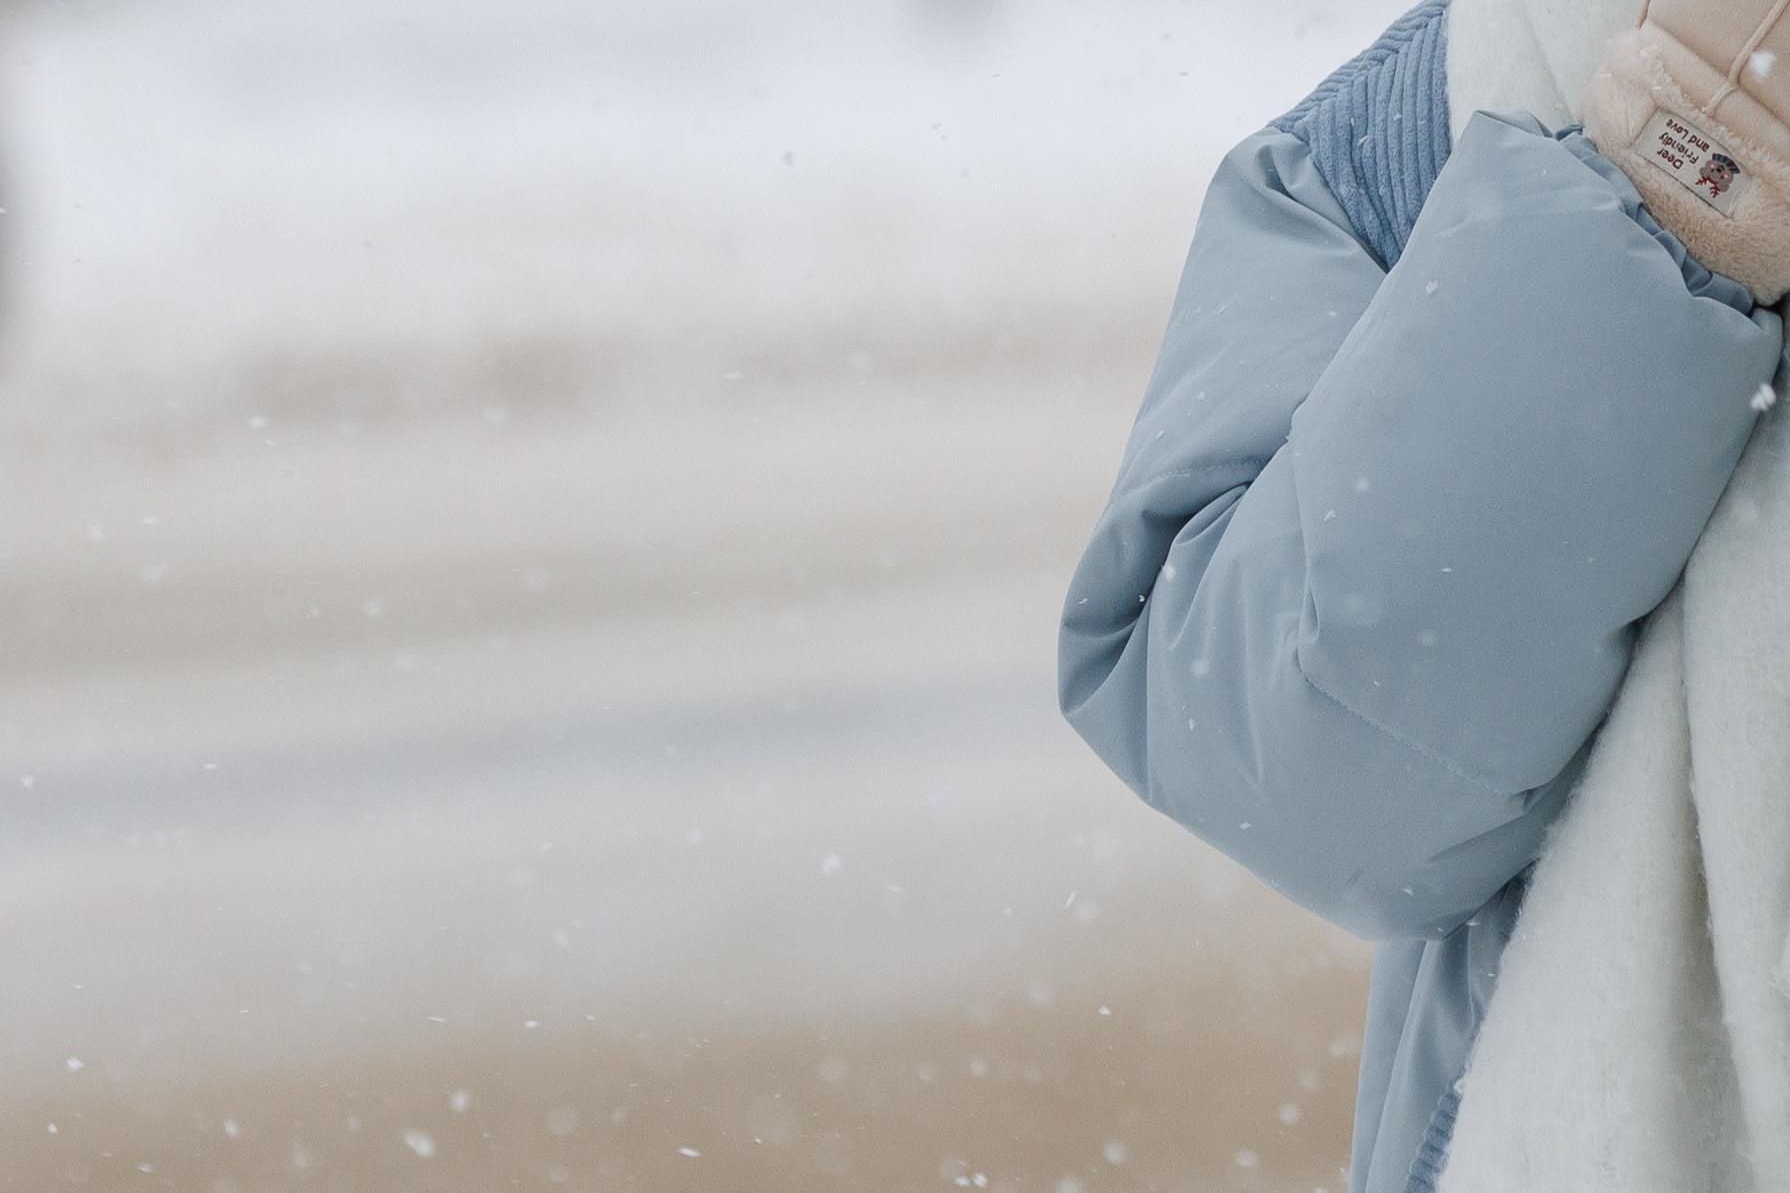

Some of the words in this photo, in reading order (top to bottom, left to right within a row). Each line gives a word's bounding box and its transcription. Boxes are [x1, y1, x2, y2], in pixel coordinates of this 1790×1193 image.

[1666, 118, 1689, 140] Love
[1658, 133, 1699, 165] Friendly
[1687, 134, 1710, 152] and
[1657, 148, 1684, 170] Deer
